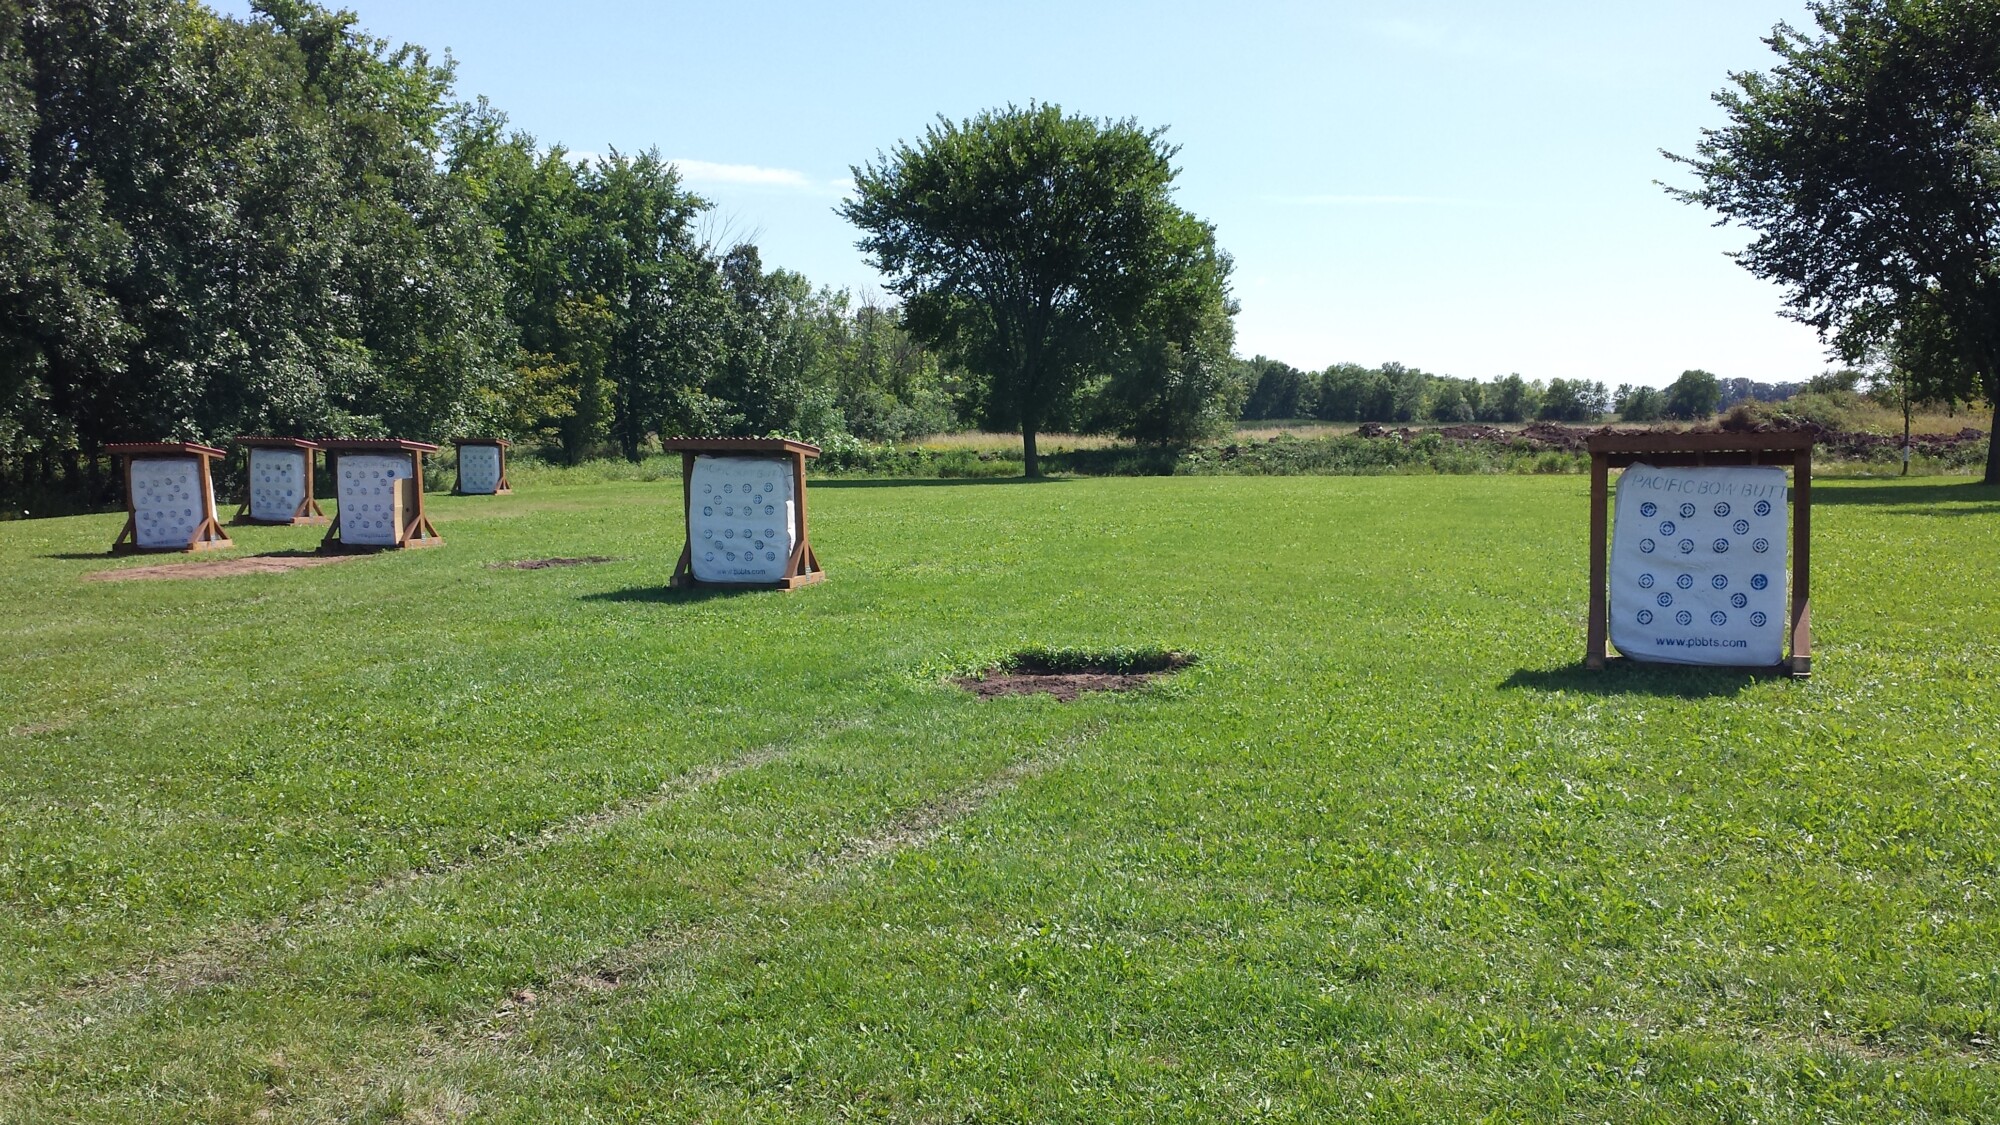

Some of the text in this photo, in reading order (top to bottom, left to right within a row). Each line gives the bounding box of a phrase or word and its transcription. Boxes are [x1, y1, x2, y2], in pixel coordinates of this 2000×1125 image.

[1632, 475, 1695, 494] PACIFIC
[1697, 479, 1736, 496] BOW
[1656, 637, 1747, 648] www.pbbts.com
